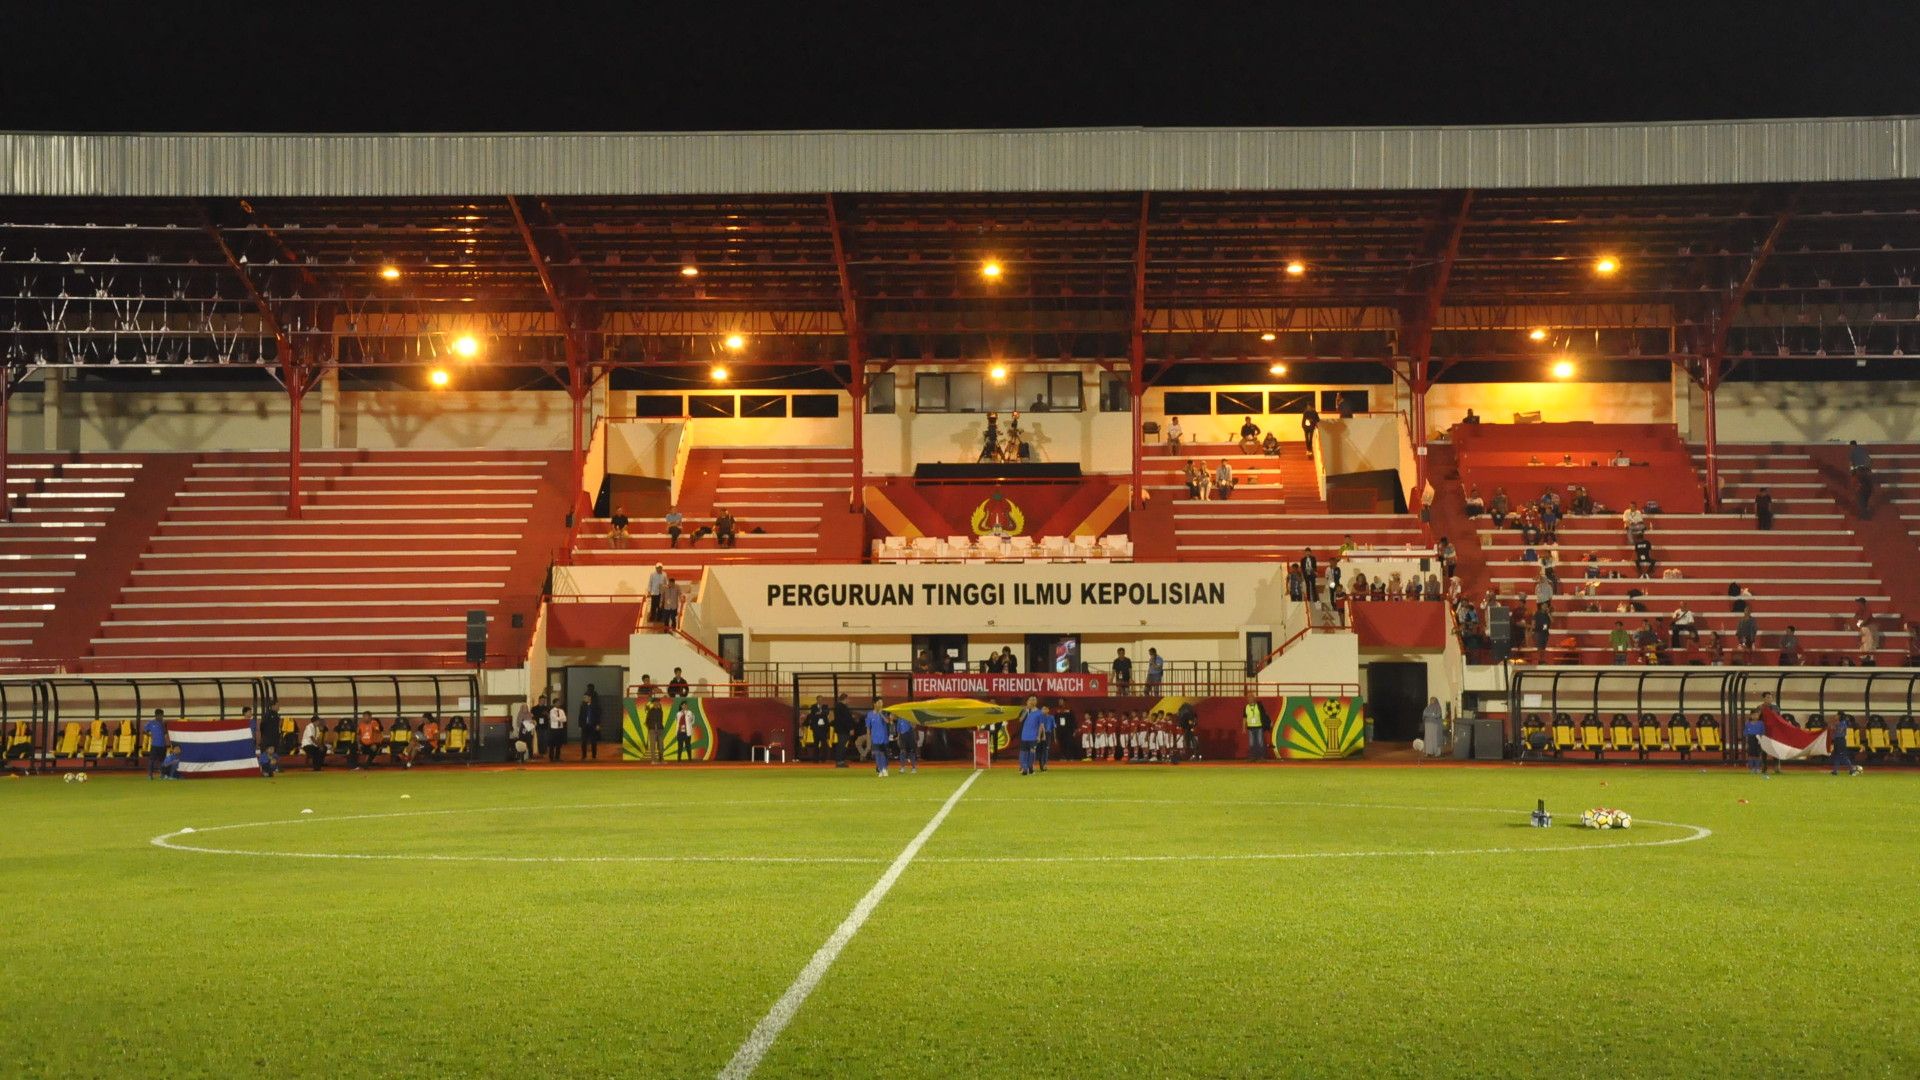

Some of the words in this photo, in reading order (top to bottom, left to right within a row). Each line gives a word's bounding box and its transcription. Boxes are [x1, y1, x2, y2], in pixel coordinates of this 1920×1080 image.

[767, 584, 914, 606] PERGURUAN
[922, 583, 1004, 605] TINGGI
[1014, 583, 1072, 605] ILMU
[1080, 582, 1225, 605] KEPOLISIAN
[914, 678, 989, 692] TERNATIONAL
[993, 678, 1043, 692] FRIENDLY
[1047, 678, 1084, 692] MATCH
